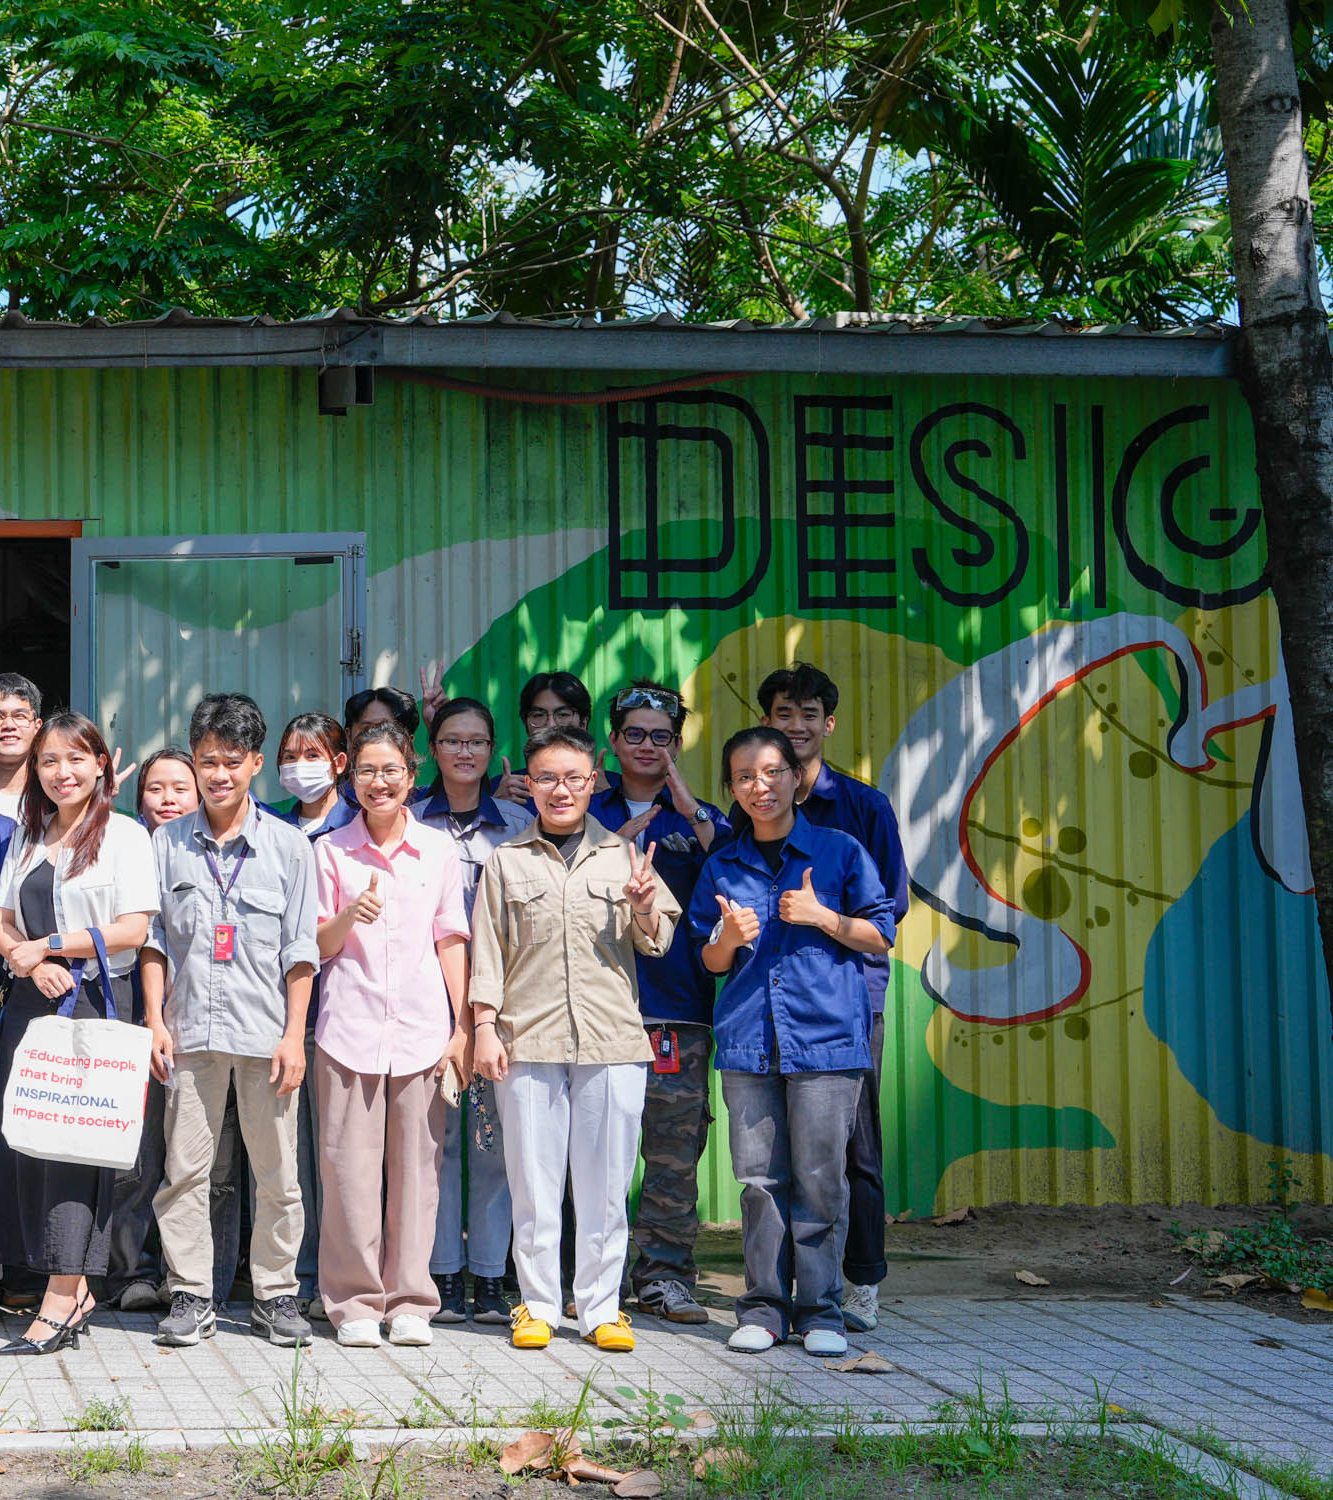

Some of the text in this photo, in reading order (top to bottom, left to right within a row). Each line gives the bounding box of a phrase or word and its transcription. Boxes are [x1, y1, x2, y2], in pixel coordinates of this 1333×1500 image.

[93, 1057, 137, 1072] people
[19, 1067, 83, 1088] that bring
[15, 1086, 119, 1109] INSPIRATIONAL
[12, 1104, 59, 1122] impact
[63, 1114, 76, 1124] to
